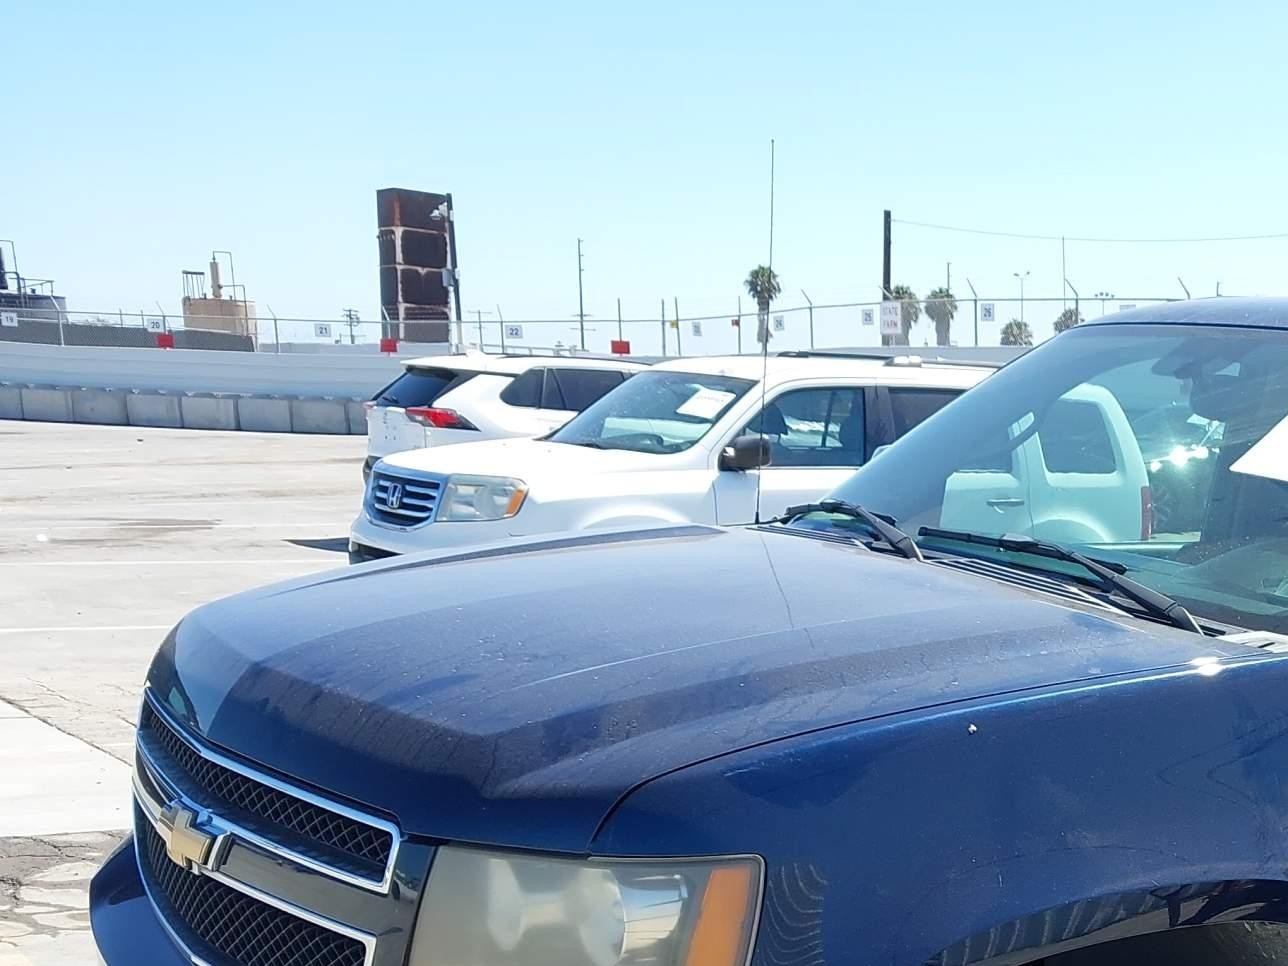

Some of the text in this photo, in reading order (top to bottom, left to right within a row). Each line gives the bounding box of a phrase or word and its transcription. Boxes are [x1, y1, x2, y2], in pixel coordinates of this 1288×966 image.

[151, 321, 160, 329] 20
[319, 326, 328, 335] 21
[509, 327, 519, 336] 22
